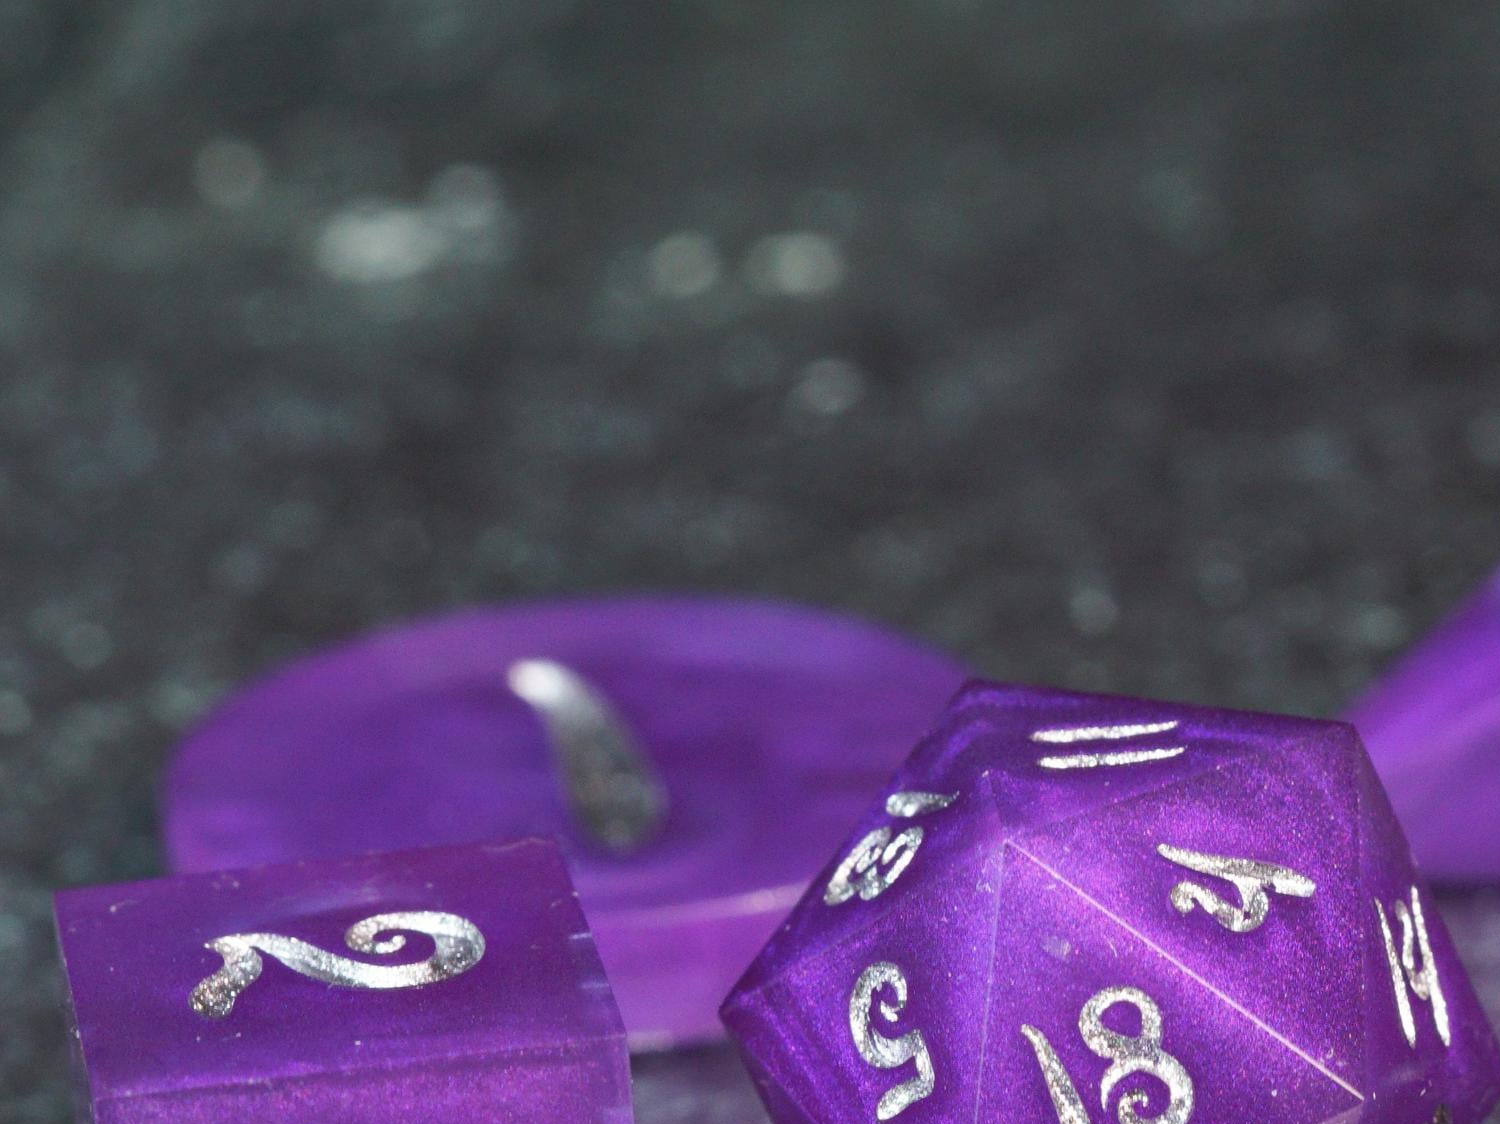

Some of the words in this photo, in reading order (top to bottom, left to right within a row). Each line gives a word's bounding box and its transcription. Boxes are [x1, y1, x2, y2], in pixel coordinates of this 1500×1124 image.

[507, 657, 668, 856] 1
[1032, 720, 1186, 769] 11
[1157, 843, 1317, 933] 4
[189, 911, 486, 1019] 2
[849, 961, 936, 1122] 5
